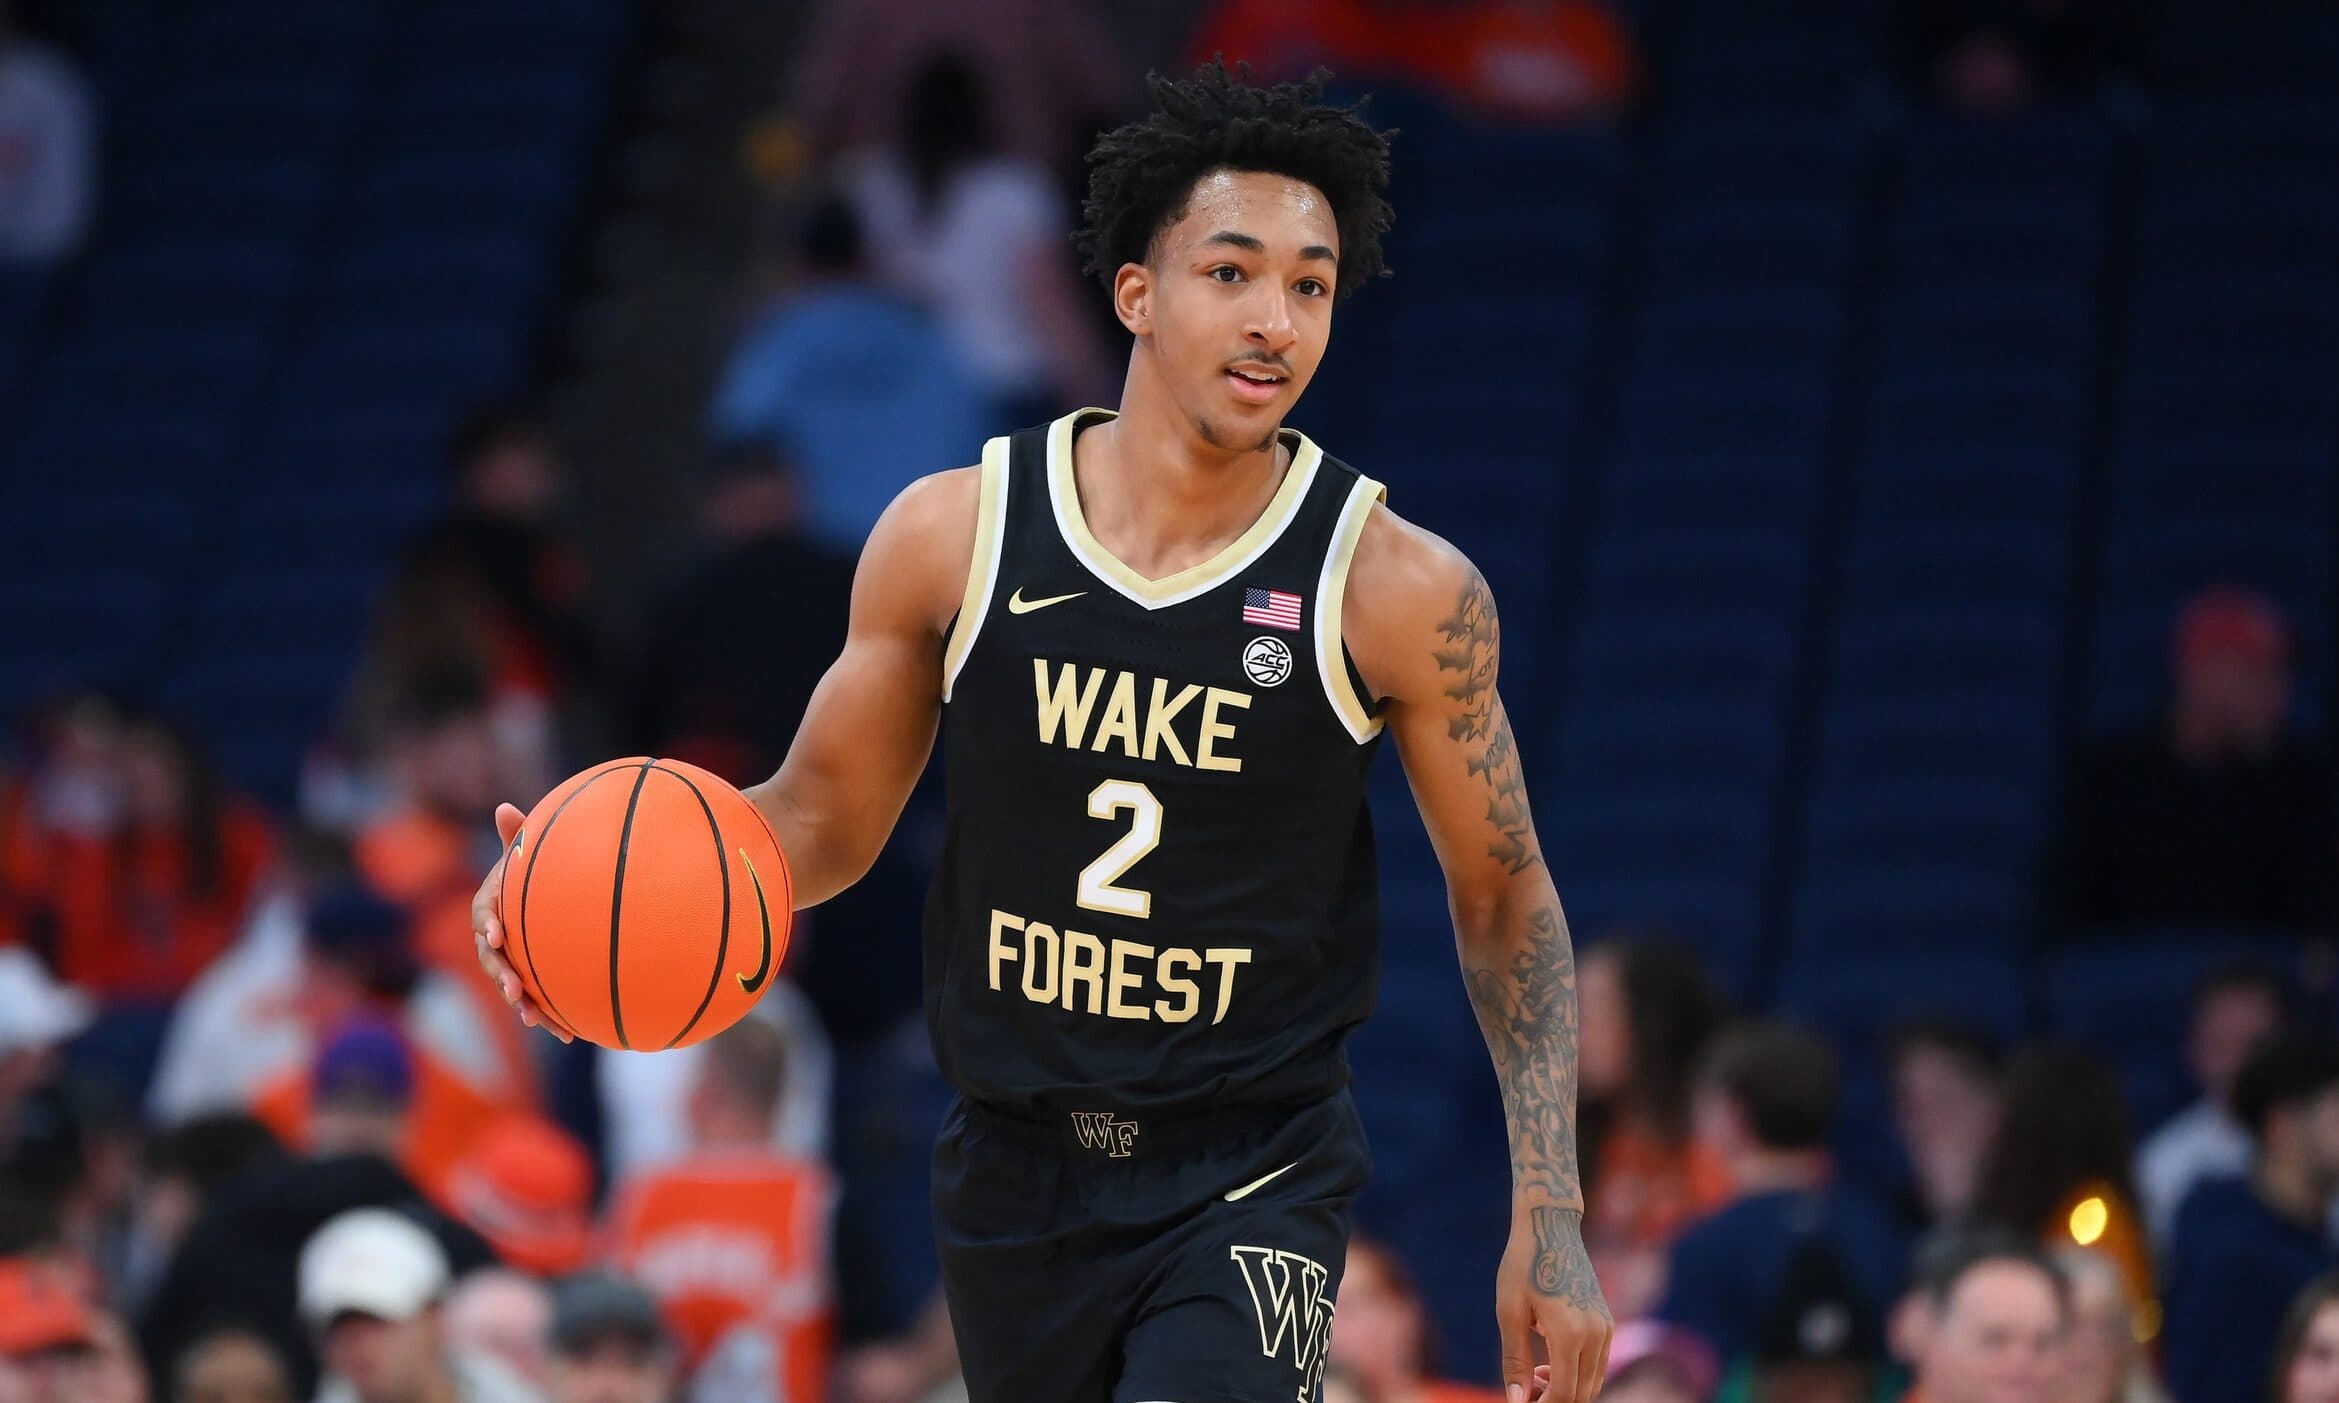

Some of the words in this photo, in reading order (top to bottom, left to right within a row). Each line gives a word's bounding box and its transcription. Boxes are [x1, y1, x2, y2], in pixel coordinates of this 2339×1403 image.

[1033, 657, 1252, 773] WAKE
[1251, 653, 1289, 668] ACC
[1076, 779, 1163, 919] 2
[989, 909, 1252, 1026] FOREST
[1071, 1112, 1139, 1158] WF
